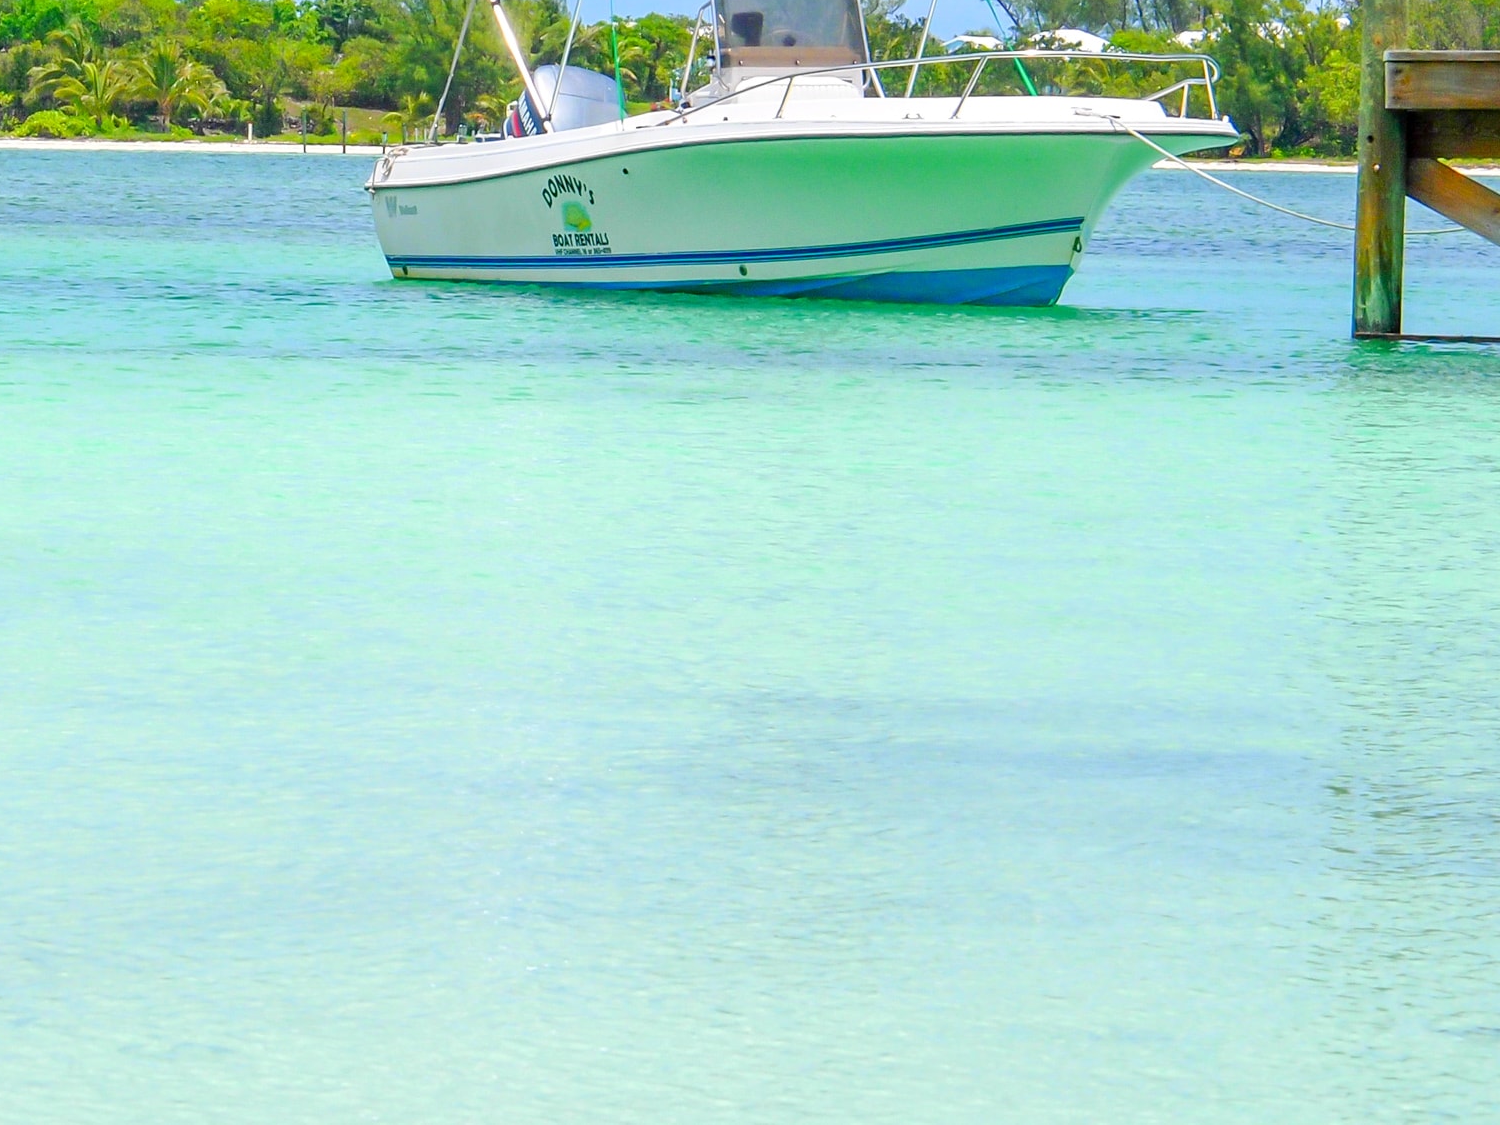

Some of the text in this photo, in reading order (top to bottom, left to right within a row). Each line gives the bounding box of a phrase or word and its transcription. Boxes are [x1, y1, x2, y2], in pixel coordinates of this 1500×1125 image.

[542, 174, 595, 209] DONNY'S
[552, 232, 609, 247] BOAT RENTALS
